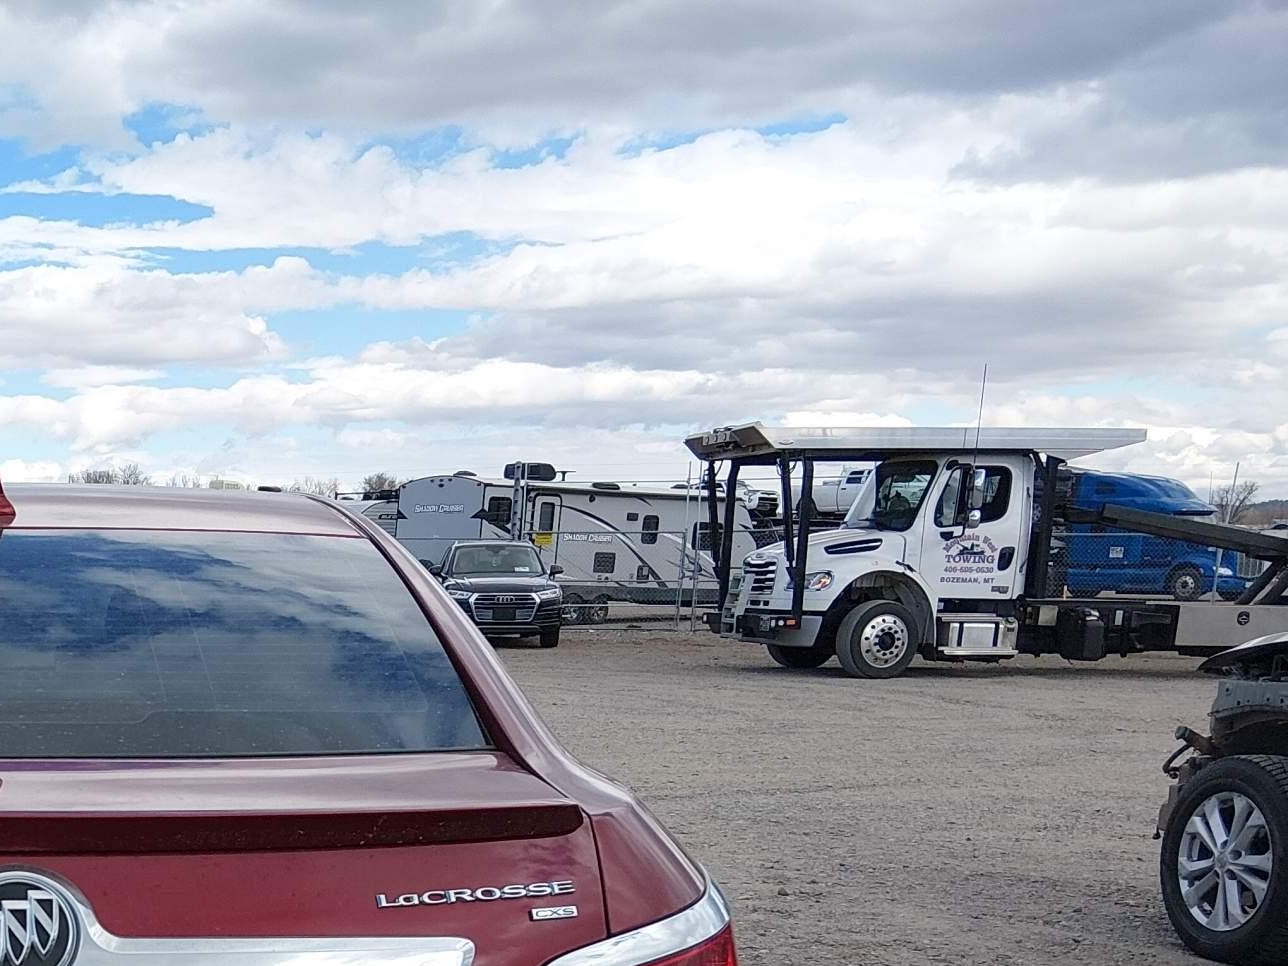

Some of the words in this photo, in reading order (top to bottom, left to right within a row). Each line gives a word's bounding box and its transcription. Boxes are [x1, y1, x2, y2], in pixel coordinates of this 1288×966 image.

[944, 554, 995, 564] TOWING
[940, 576, 981, 584] BOZEMAN,
[534, 907, 575, 919] CXS
